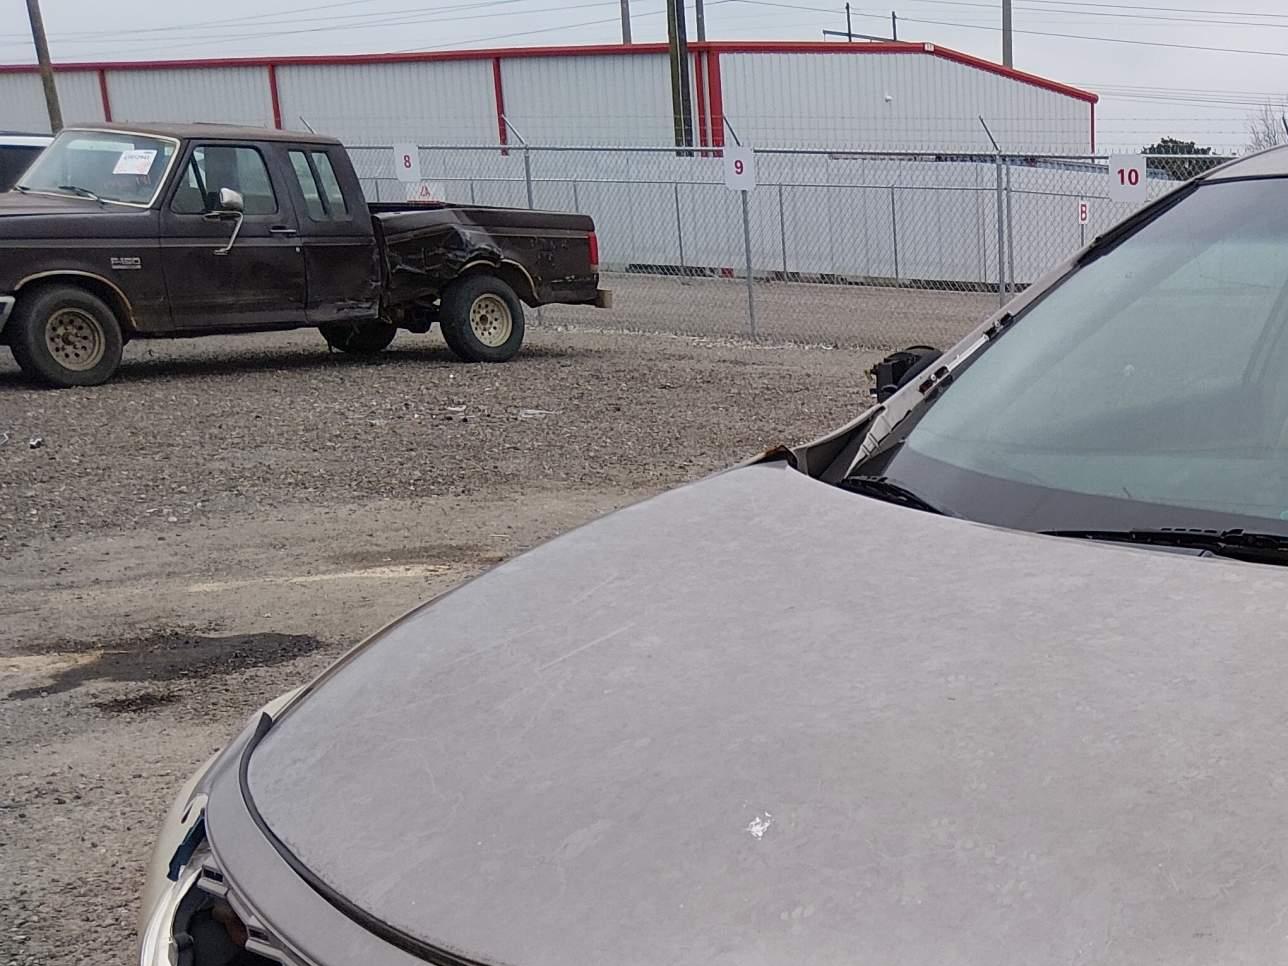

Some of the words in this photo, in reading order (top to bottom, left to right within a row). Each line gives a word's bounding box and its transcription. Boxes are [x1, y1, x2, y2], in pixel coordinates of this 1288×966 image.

[403, 154, 412, 169] 8
[734, 159, 744, 175] 9
[1117, 168, 1139, 186] 10
[1080, 203, 1087, 221] B
